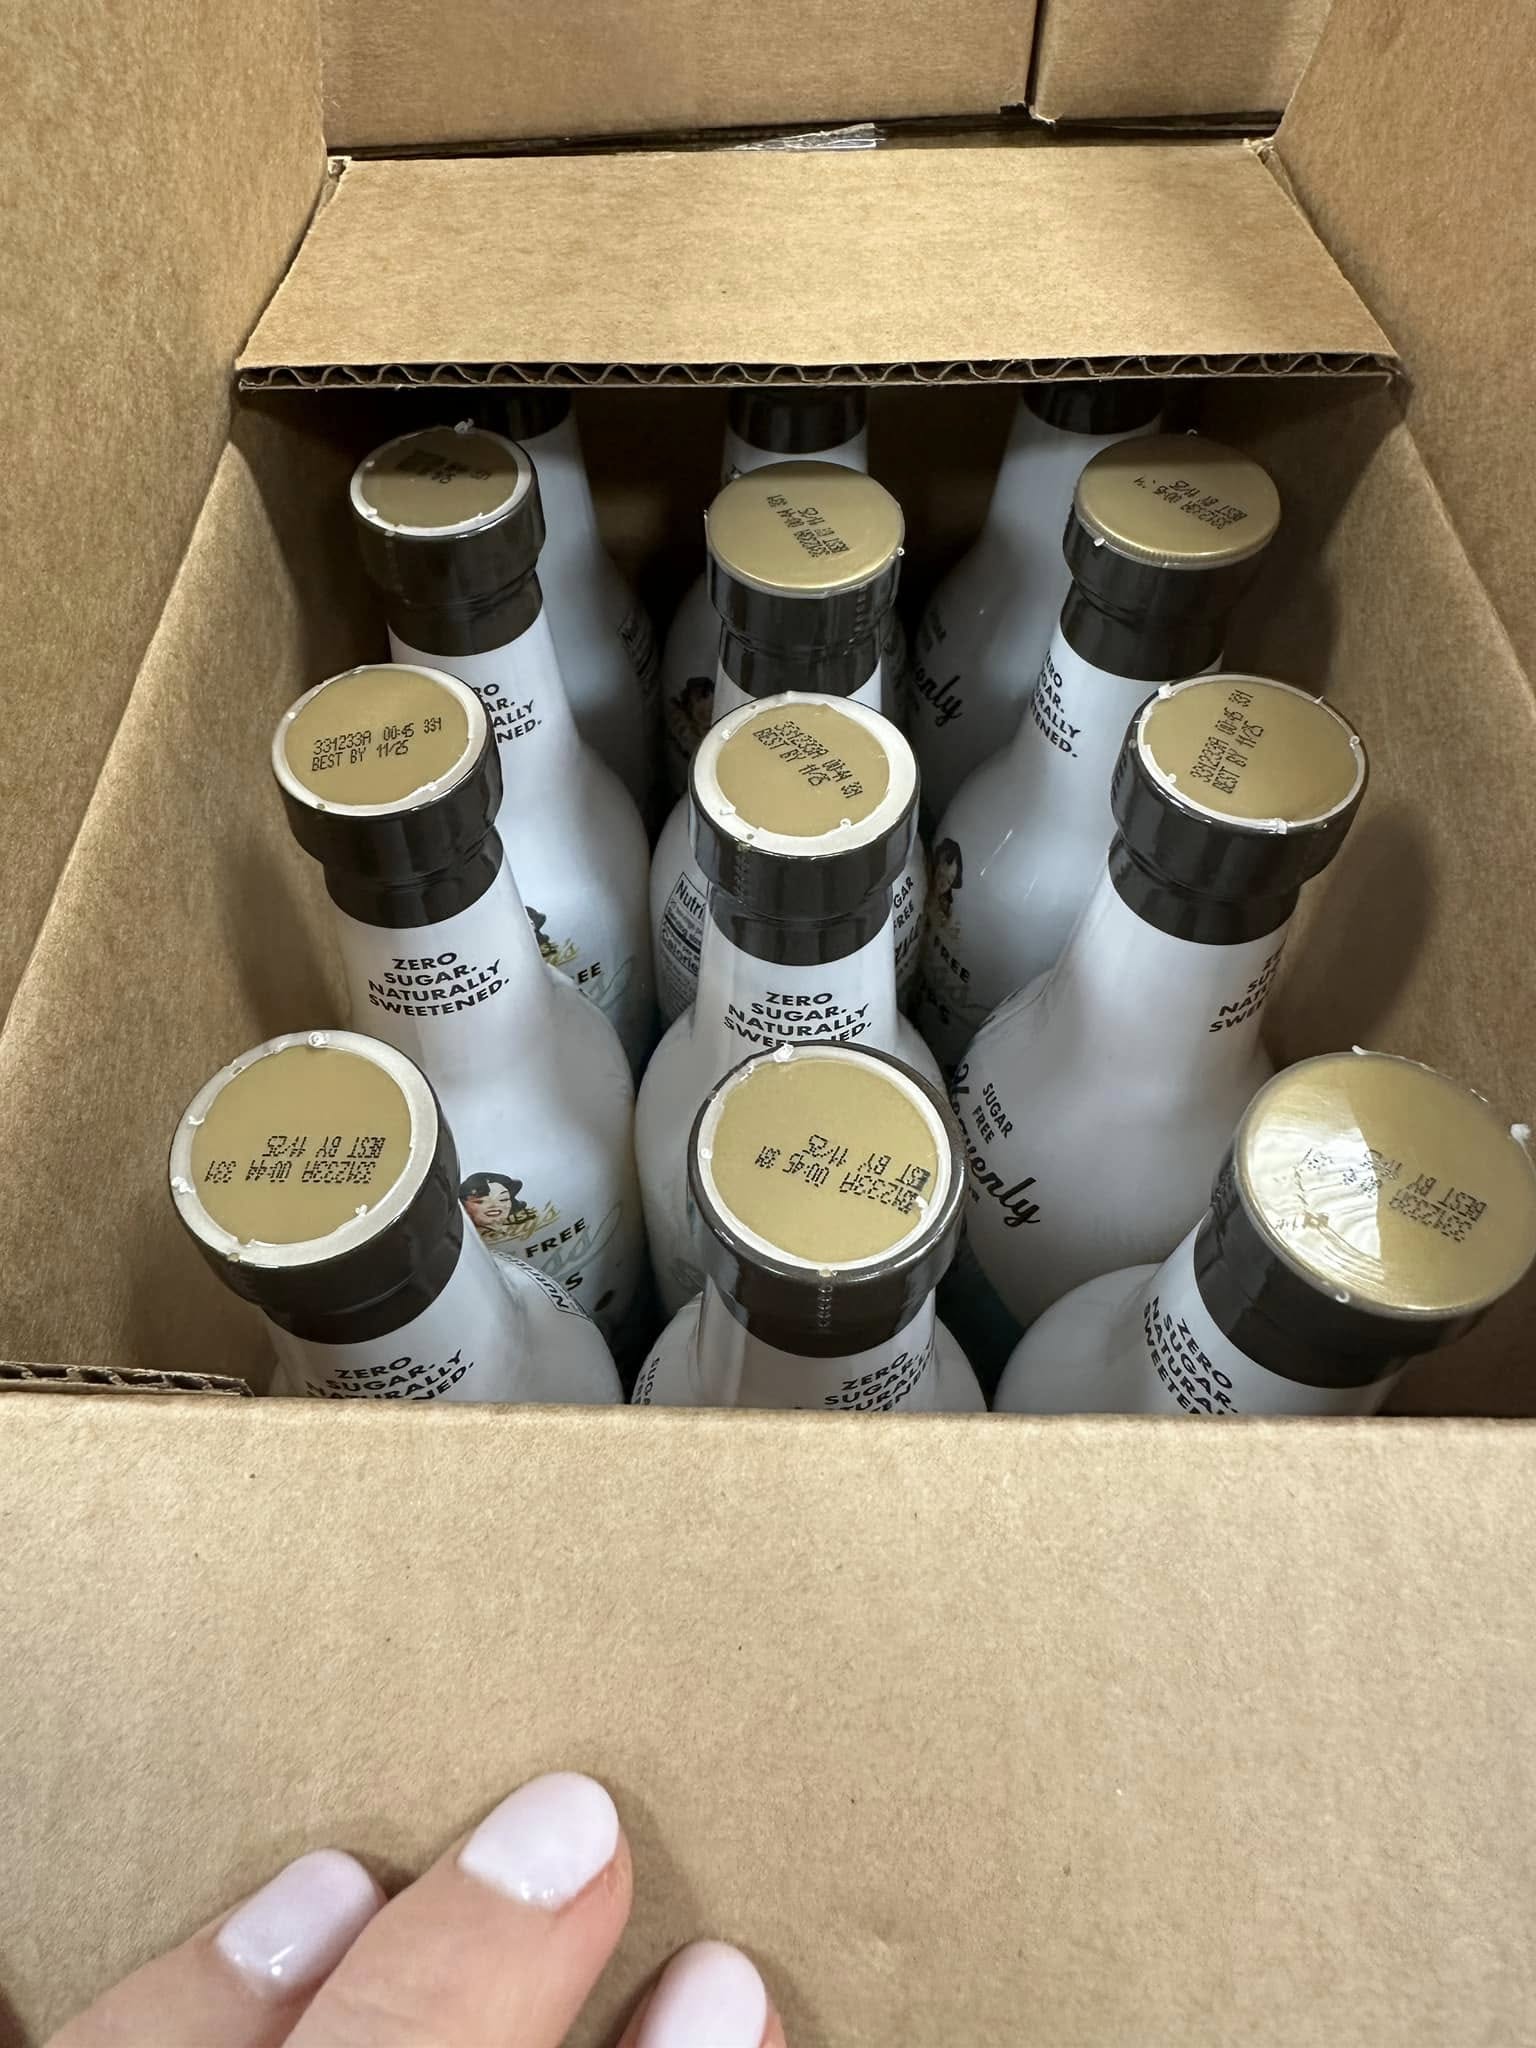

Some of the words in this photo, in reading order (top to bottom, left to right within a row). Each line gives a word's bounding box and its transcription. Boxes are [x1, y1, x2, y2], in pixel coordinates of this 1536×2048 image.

[472, 684, 499, 698] RO
[485, 698, 515, 713] AR.
[493, 700, 533, 728] ALLY
[496, 719, 542, 744] NED.
[752, 727, 789, 750] BEST
[779, 749, 806, 762] BY
[312, 751, 343, 771] BEST
[350, 748, 366, 764] BY
[376, 740, 409, 758] 11/25
[1225, 748, 1248, 768] BY
[1212, 766, 1240, 794] BEST
[676, 879, 705, 919] Nutri
[894, 876, 913, 908] GAR
[392, 952, 457, 970] ZERO
[577, 962, 601, 984] EE
[368, 959, 500, 1001] NATURALLY
[384, 965, 477, 986] SUGAR.
[368, 978, 509, 1016] SWEETENED.
[766, 992, 832, 1006] ZERO
[728, 1003, 869, 1036] NATURALLY
[752, 1002, 847, 1021] SUGAR.
[972, 1105, 995, 1144] FREE
[983, 1083, 1013, 1139] SUGAR
[262, 1136, 307, 1158] 11/25
[315, 1136, 342, 1158] BY
[346, 1136, 386, 1158] BEST
[802, 1134, 849, 1167] 11/25
[204, 1160, 236, 1184] 331
[245, 1159, 292, 1184] 00:44
[857, 1153, 892, 1176] BY
[1438, 1187, 1488, 1223] BEST
[525, 1217, 587, 1258] FREE
[1153, 1296, 1225, 1415] NATURA
[1164, 1313, 1238, 1414] SUGAR.
[1177, 1318, 1232, 1389] ZERO
[325, 1364, 435, 1392] SUGAR.
[334, 1357, 412, 1379] ZERO
[842, 1352, 908, 1391] ZERO
